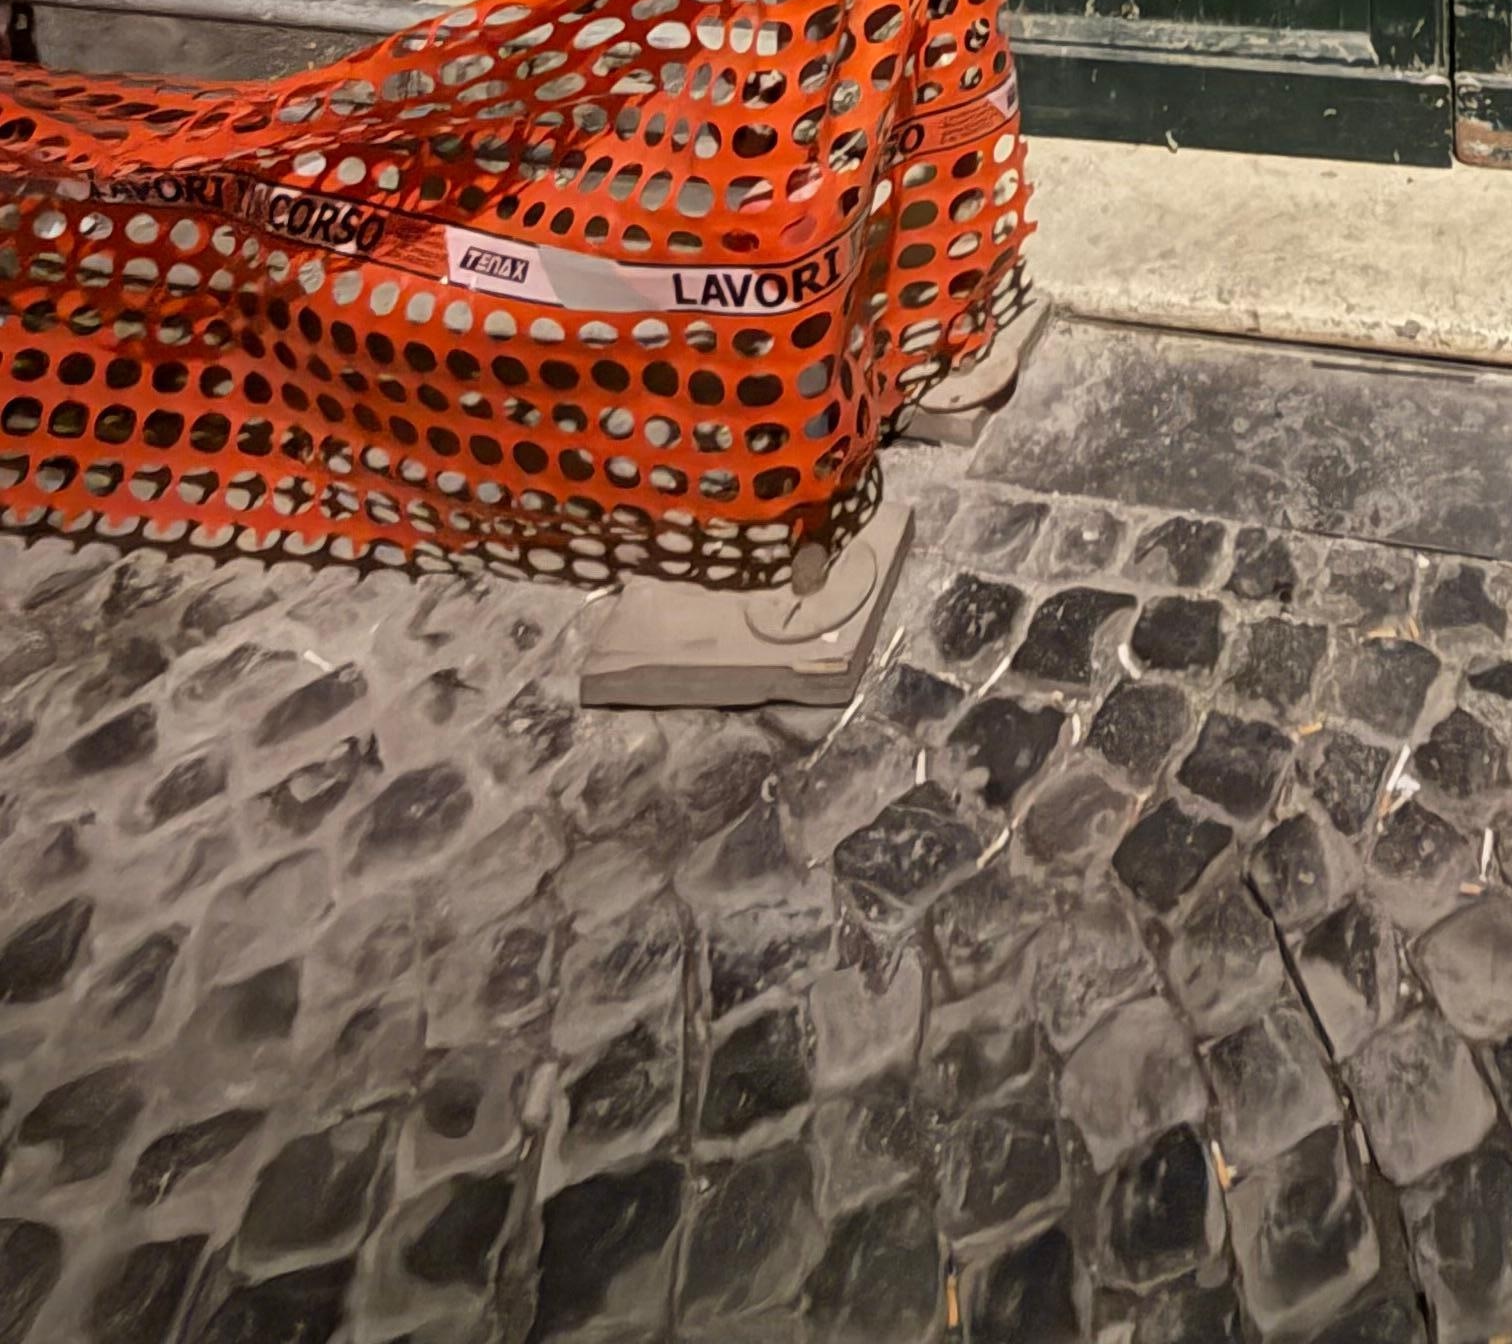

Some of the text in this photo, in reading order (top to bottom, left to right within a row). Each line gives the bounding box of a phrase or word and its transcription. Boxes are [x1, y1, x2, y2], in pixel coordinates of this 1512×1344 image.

[268, 193, 386, 254] CORSO
[463, 249, 529, 283] TENAX
[672, 245, 842, 309] LAVORI
